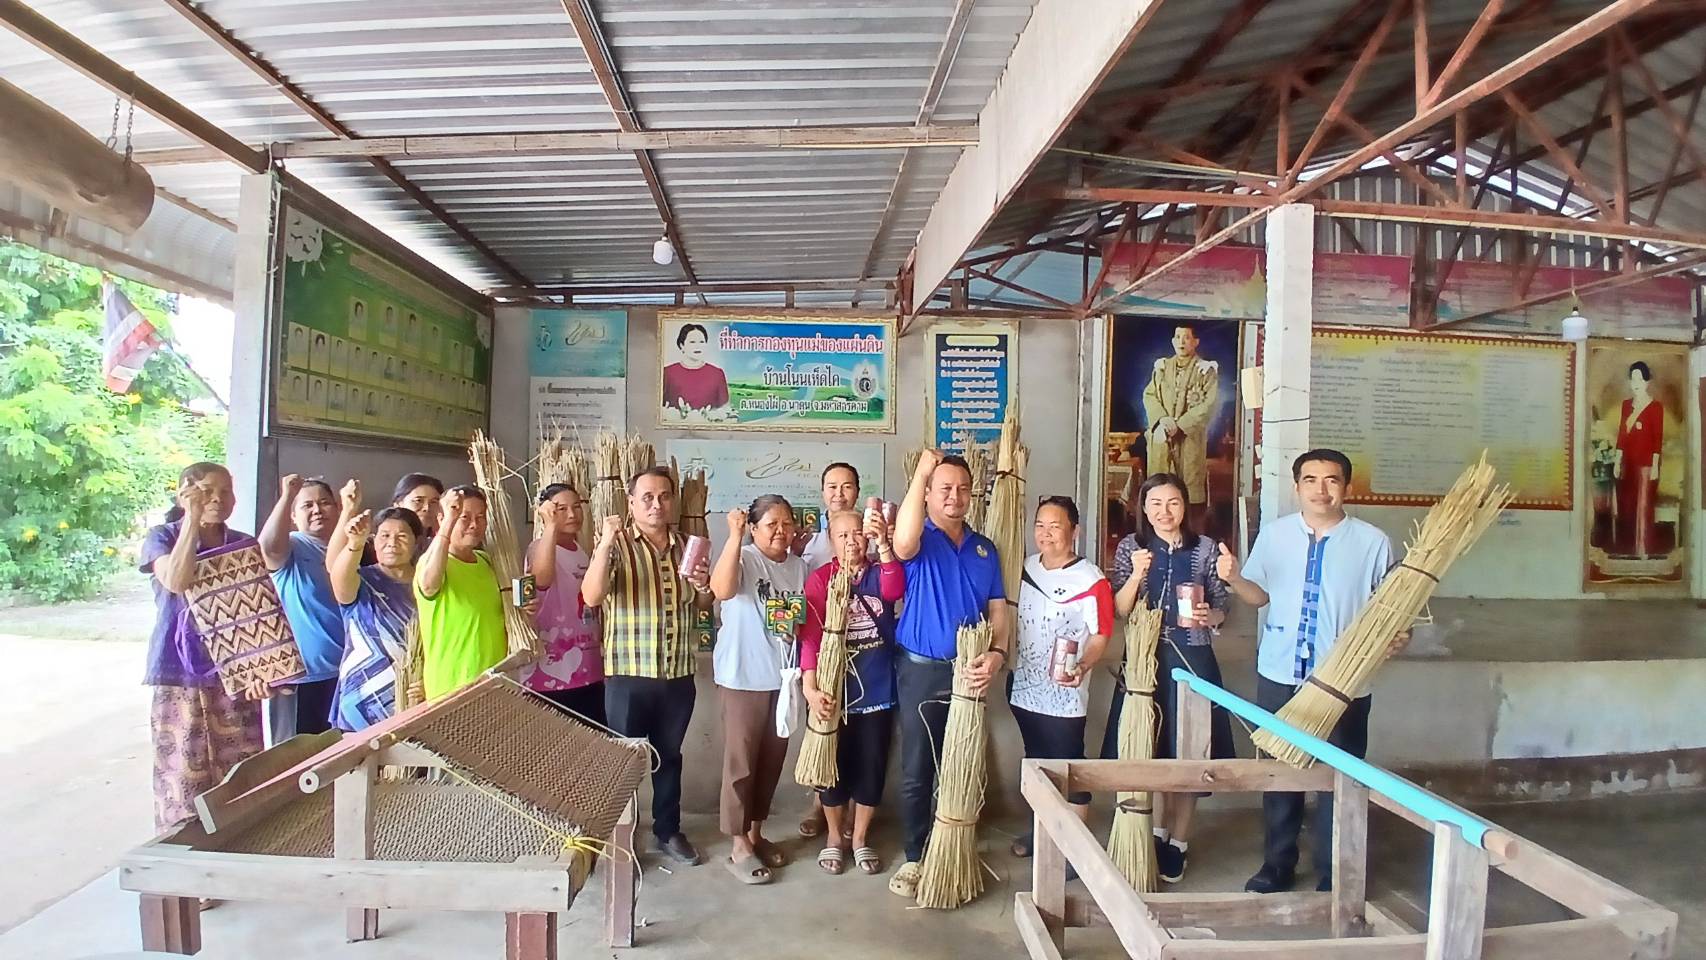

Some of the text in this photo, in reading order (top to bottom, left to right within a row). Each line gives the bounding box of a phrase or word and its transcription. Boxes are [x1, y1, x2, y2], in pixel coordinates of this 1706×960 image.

[720, 327, 884, 359] ที่ทำการกองทุนแม่ของแผ่นดิน
[813, 400, 868, 413] จ.มหาสารคาม
